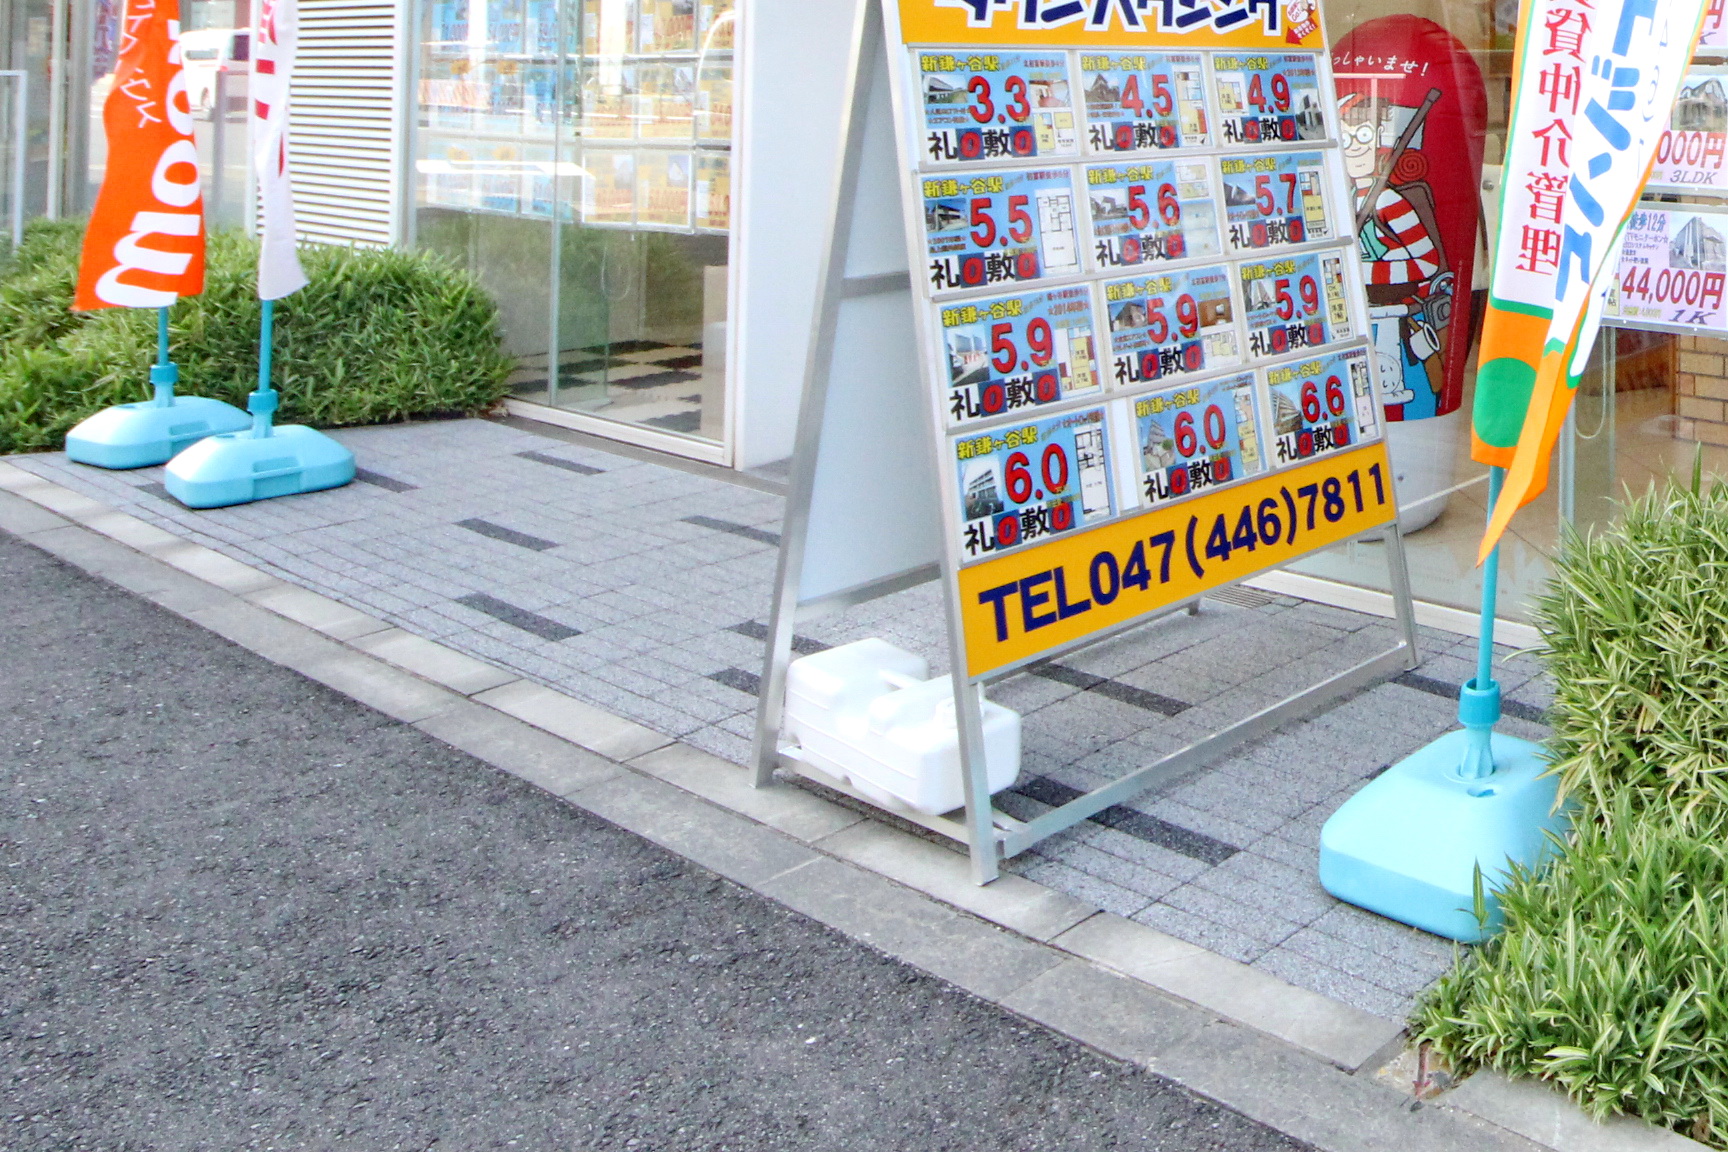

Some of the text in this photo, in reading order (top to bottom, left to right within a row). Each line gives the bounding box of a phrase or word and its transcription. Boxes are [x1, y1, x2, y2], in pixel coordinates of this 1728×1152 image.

[1670, 170, 1717, 185] 3LDK
[1621, 266, 1726, 310] 44,000円
[1668, 309, 1716, 325] 1K
